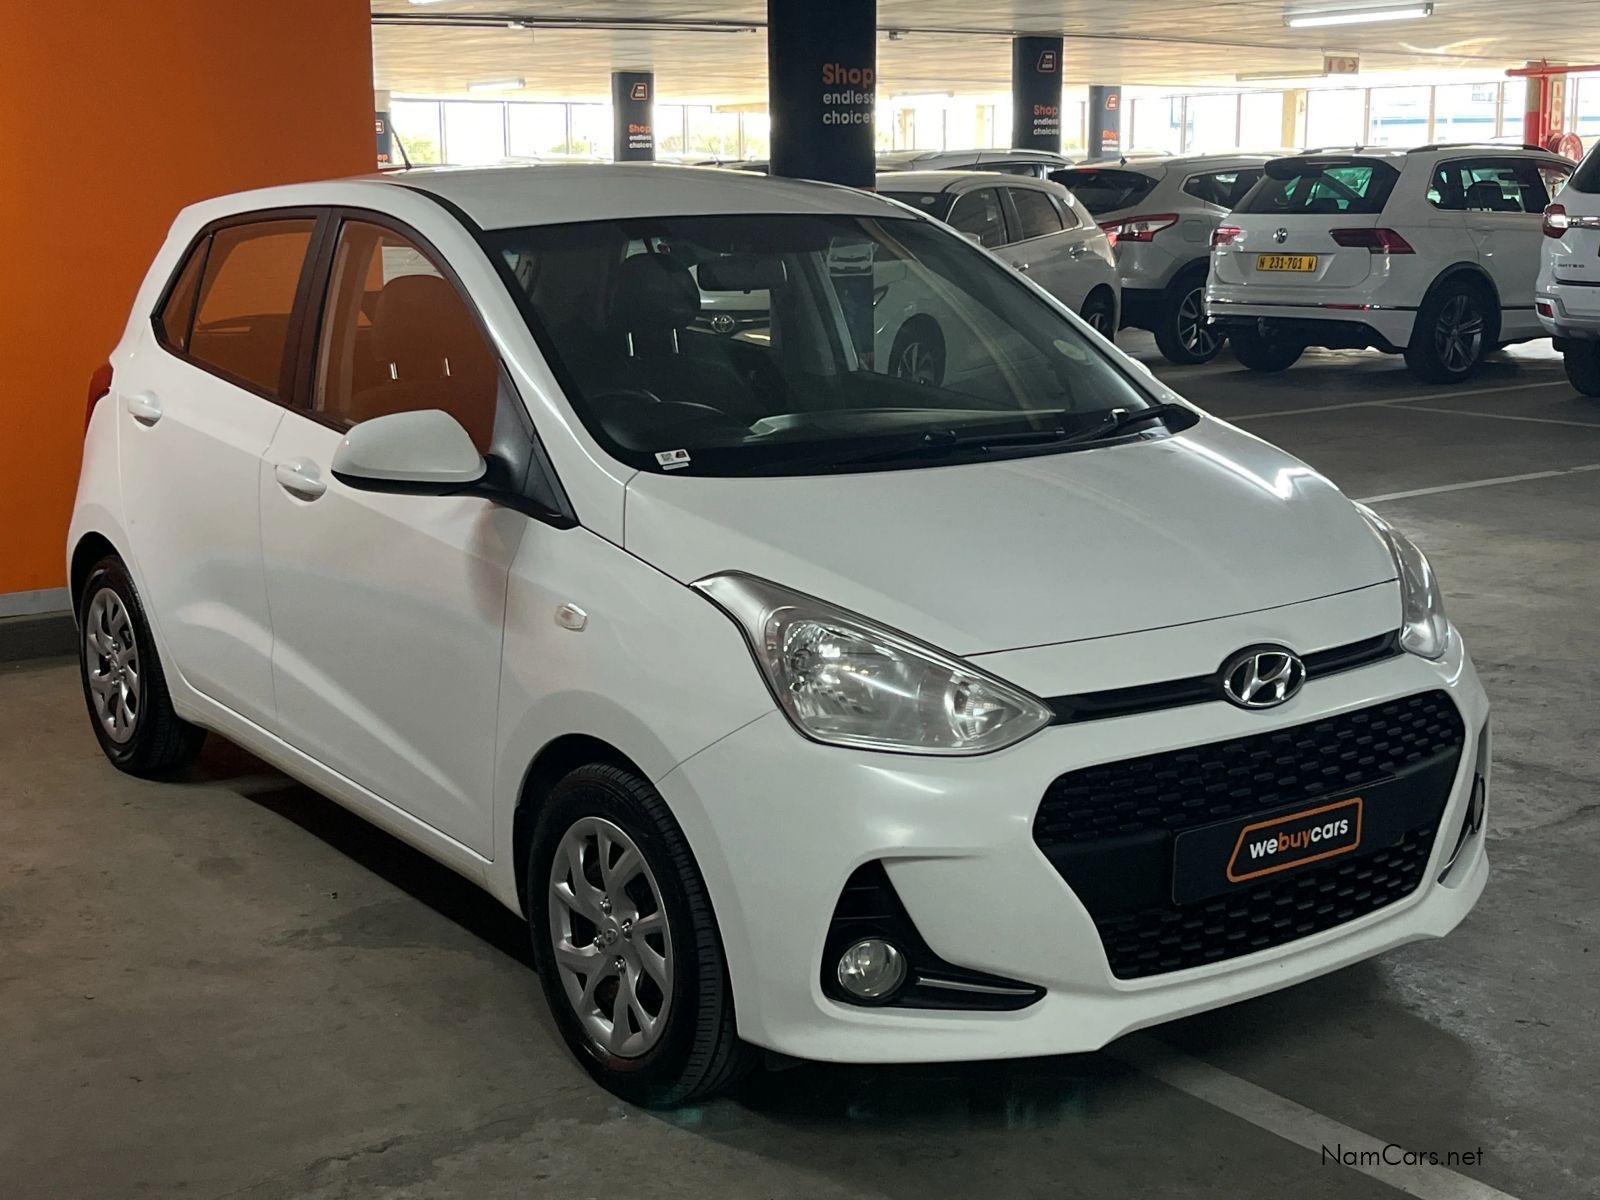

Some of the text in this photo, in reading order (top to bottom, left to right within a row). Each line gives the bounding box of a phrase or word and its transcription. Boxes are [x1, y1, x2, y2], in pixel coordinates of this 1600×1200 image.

[822, 63, 874, 88] Shop
[823, 90, 875, 105] endless
[1033, 104, 1057, 117] Shop
[629, 124, 651, 134] Shop
[1269, 256, 1303, 270] 231-701
[1249, 818, 1349, 860] webuycars
